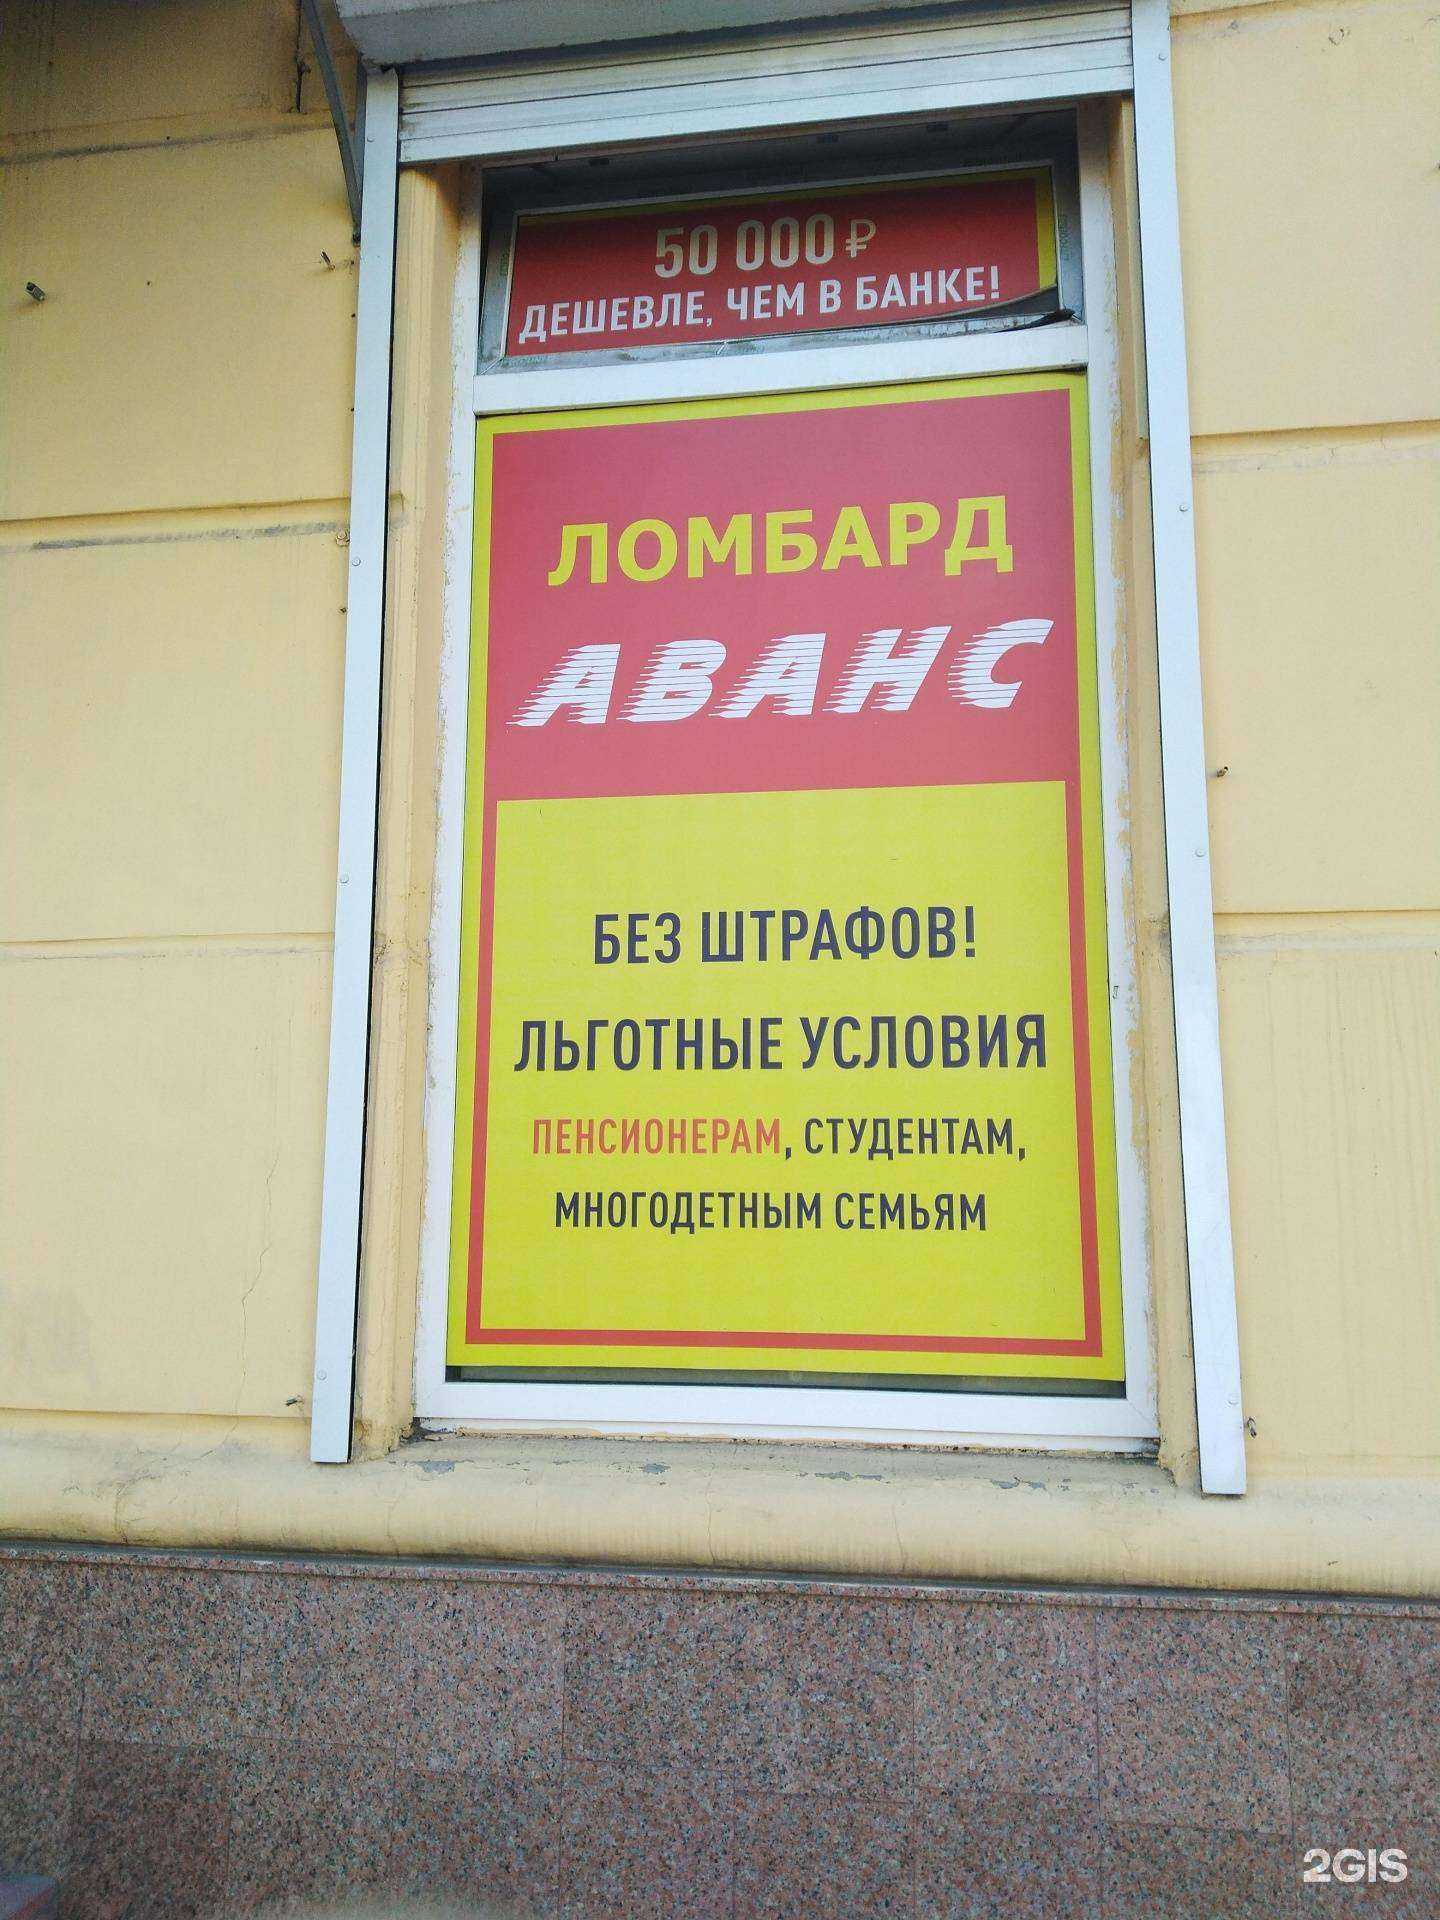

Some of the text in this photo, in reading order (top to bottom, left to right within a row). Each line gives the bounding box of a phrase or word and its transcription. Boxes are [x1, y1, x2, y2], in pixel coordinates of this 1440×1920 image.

[654, 224, 719, 279] 50
[518, 266, 1001, 344] ДЕШЕВЛЕ, ЧЕМ В БАНКЕ!
[547, 495, 1014, 587] ЛОМБАРД
[505, 618, 1055, 728] АВАНС
[594, 905, 977, 965] БЕЗ ШТРАФОВ!
[513, 1013, 1048, 1073] ЛЬГОТНЫЕ УСЛОВИЯ
[531, 1117, 1027, 1162] ПЕНСИОНЕРАМ, СТУДЕНТАМ,
[554, 1191, 987, 1235] МНОГОДЕТНЫМ СЕМЬЯМ
